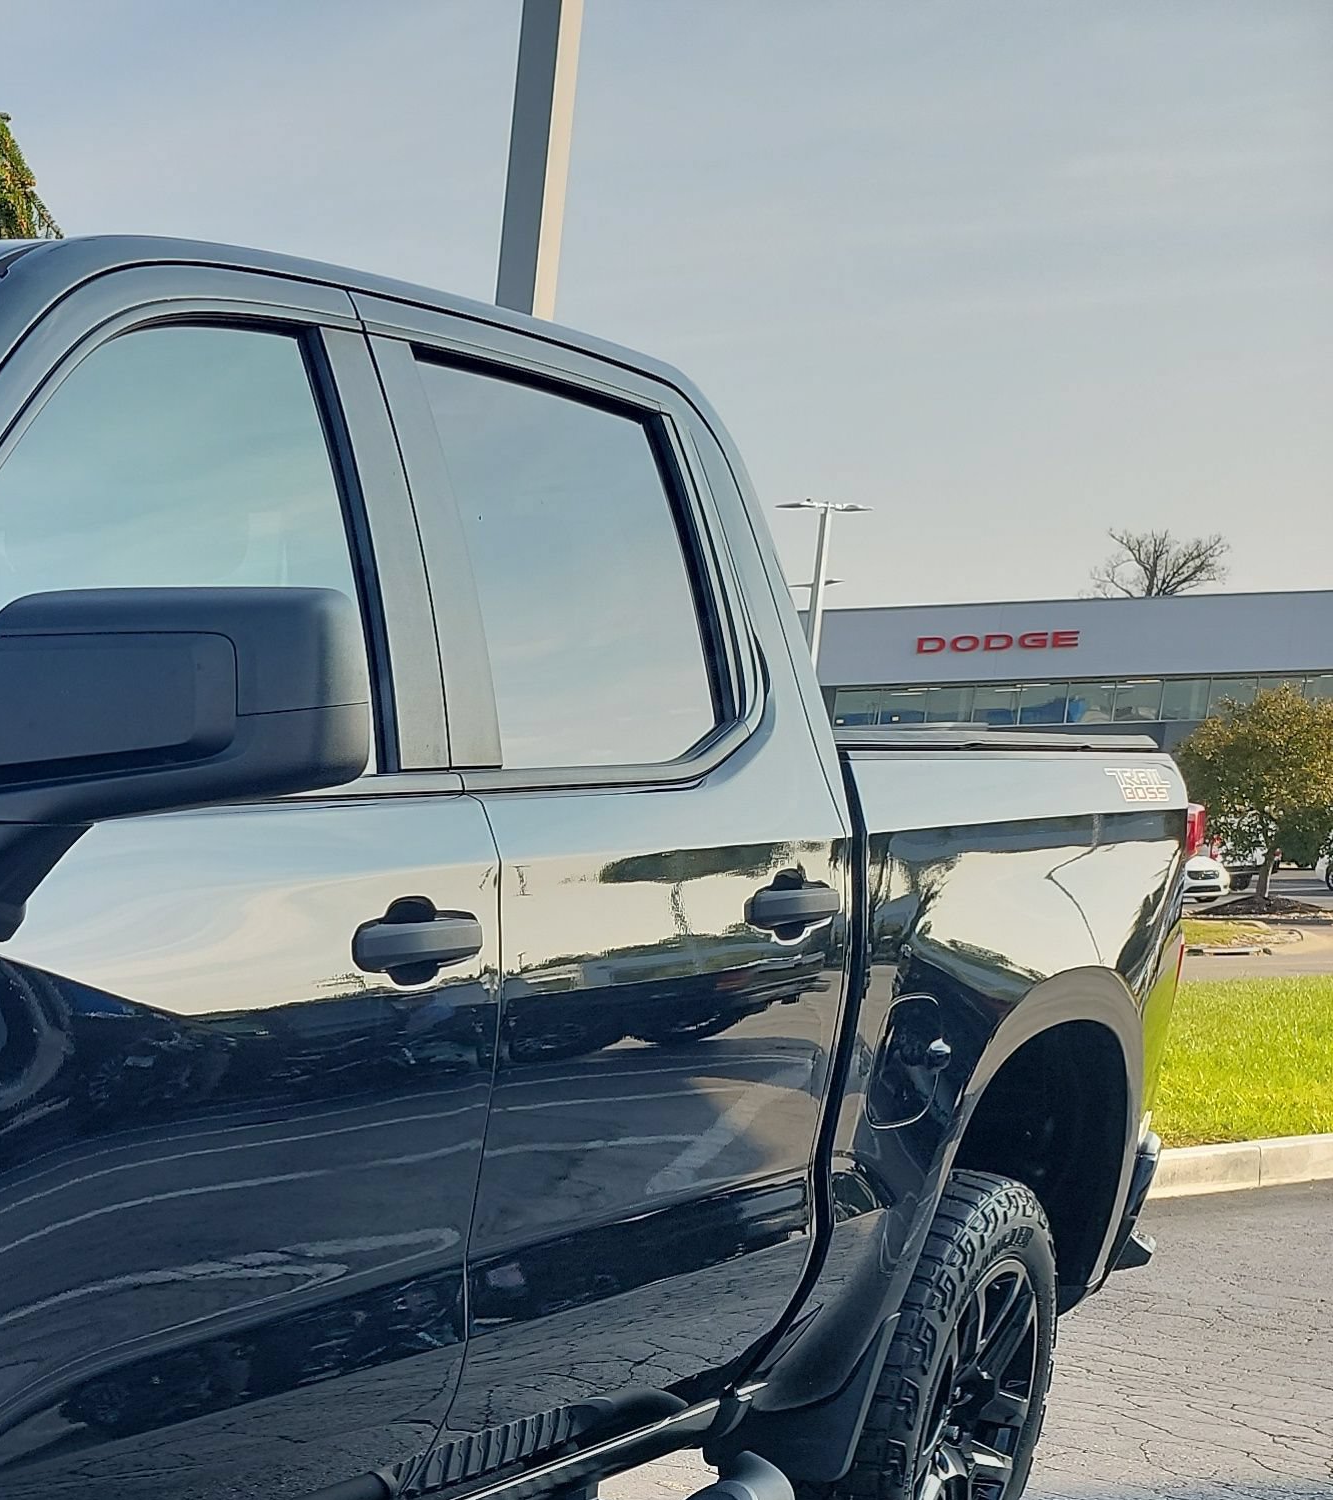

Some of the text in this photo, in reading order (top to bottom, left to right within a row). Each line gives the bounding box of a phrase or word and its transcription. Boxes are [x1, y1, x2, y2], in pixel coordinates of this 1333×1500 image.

[916, 630, 1081, 656] DODGE
[1103, 768, 1172, 788] TRAIL
[1121, 785, 1170, 802] BOSS
